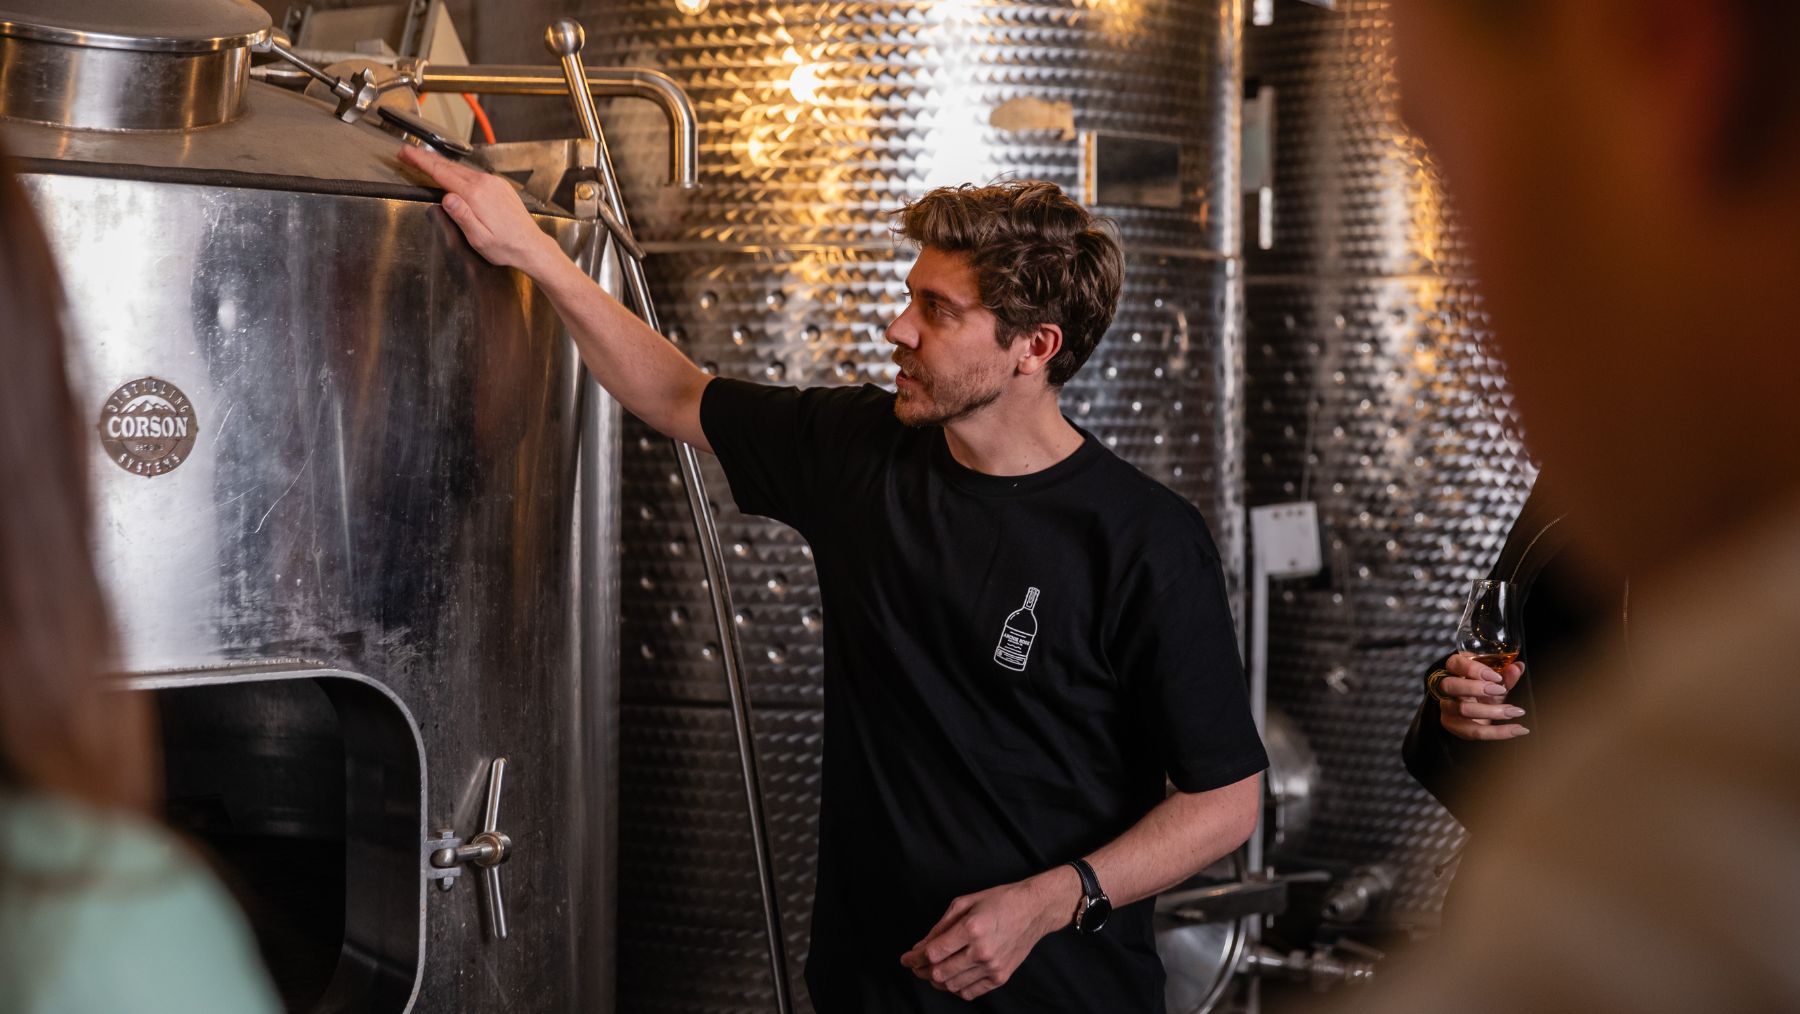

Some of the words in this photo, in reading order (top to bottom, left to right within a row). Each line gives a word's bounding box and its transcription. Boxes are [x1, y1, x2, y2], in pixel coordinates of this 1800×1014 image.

[105, 381, 189, 413] DISTILLING
[107, 416, 189, 438] CORSON
[118, 452, 180, 474] SYSTEMS
